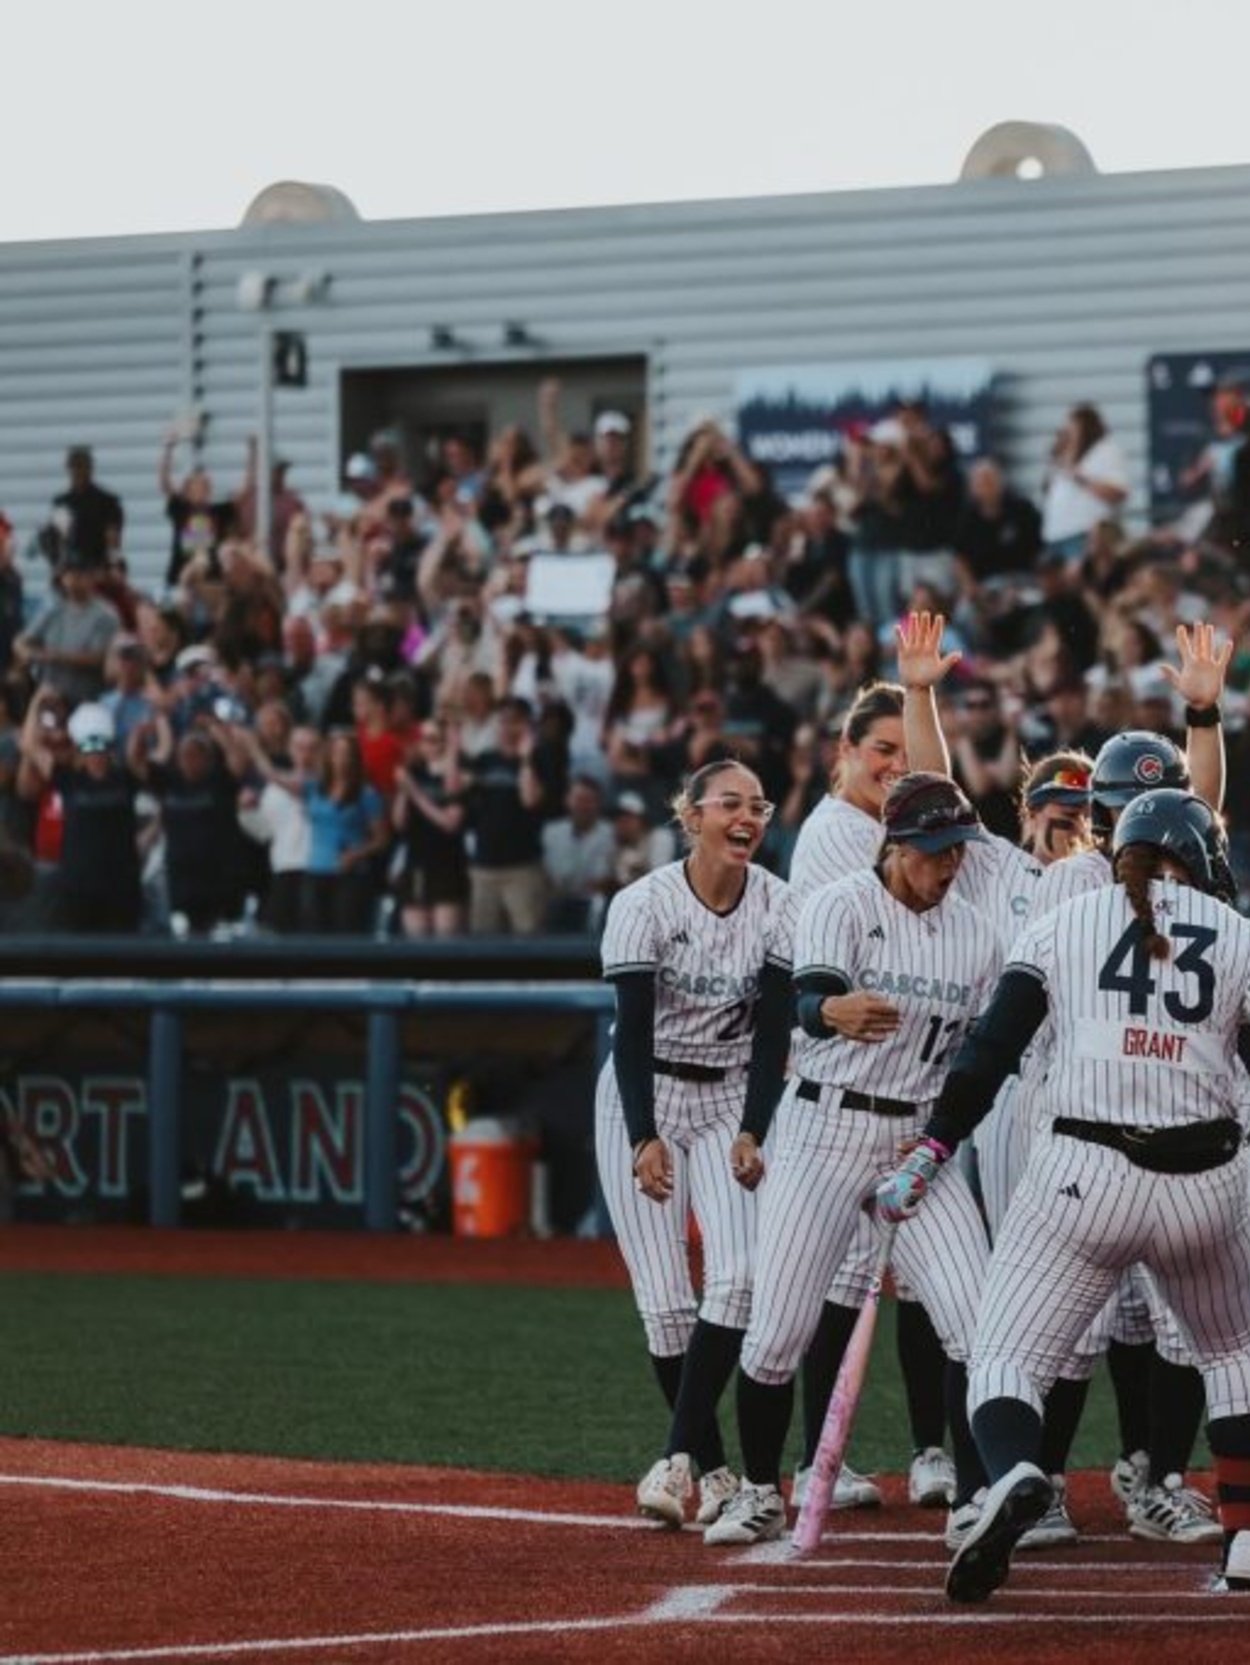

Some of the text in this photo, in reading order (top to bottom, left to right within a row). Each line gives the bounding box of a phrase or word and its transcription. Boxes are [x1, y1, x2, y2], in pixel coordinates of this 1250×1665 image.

[660, 965, 760, 997] CASCAD
[859, 967, 972, 1007] CASCADE
[1098, 916, 1218, 1025] 43
[1122, 1027, 1188, 1063] GRANT
